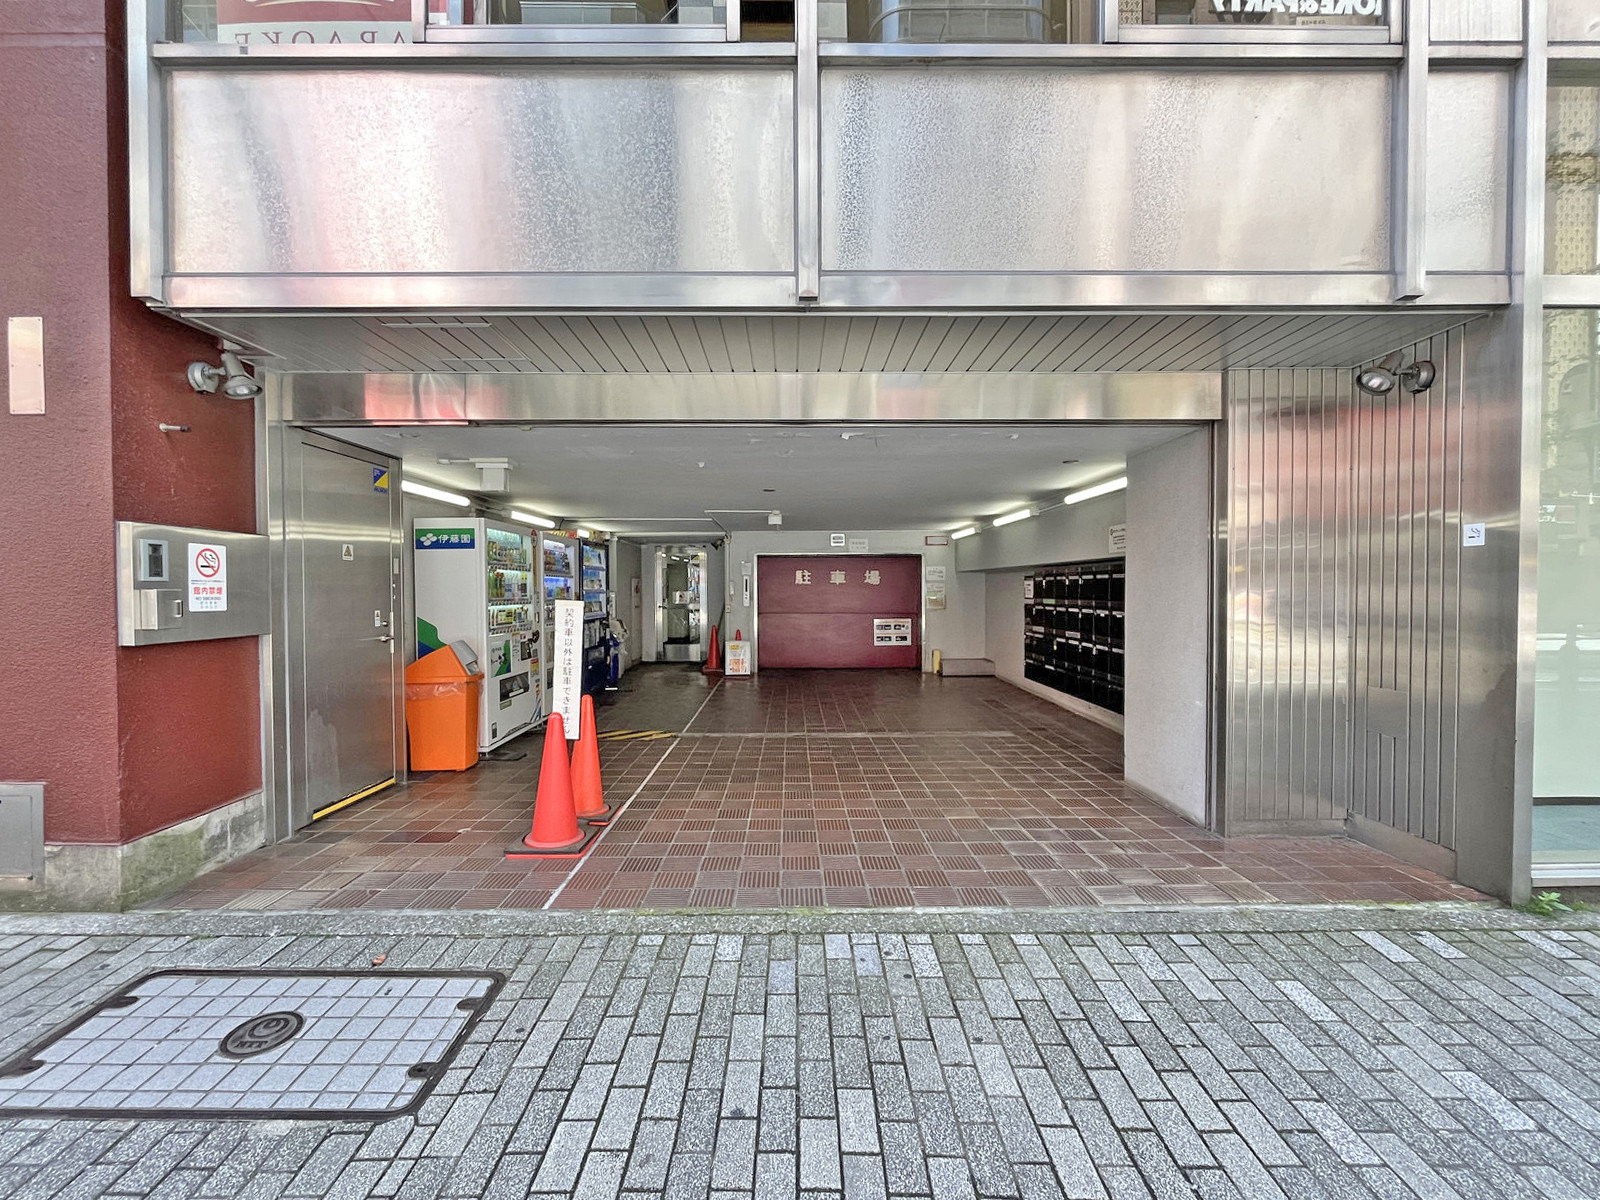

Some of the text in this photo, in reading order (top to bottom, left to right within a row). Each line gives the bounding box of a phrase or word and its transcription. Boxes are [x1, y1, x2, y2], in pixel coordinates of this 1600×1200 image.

[438, 534, 471, 544] 伊藤園
[794, 569, 881, 585] 駐車場
[234, 1040, 268, 1049] NTT
